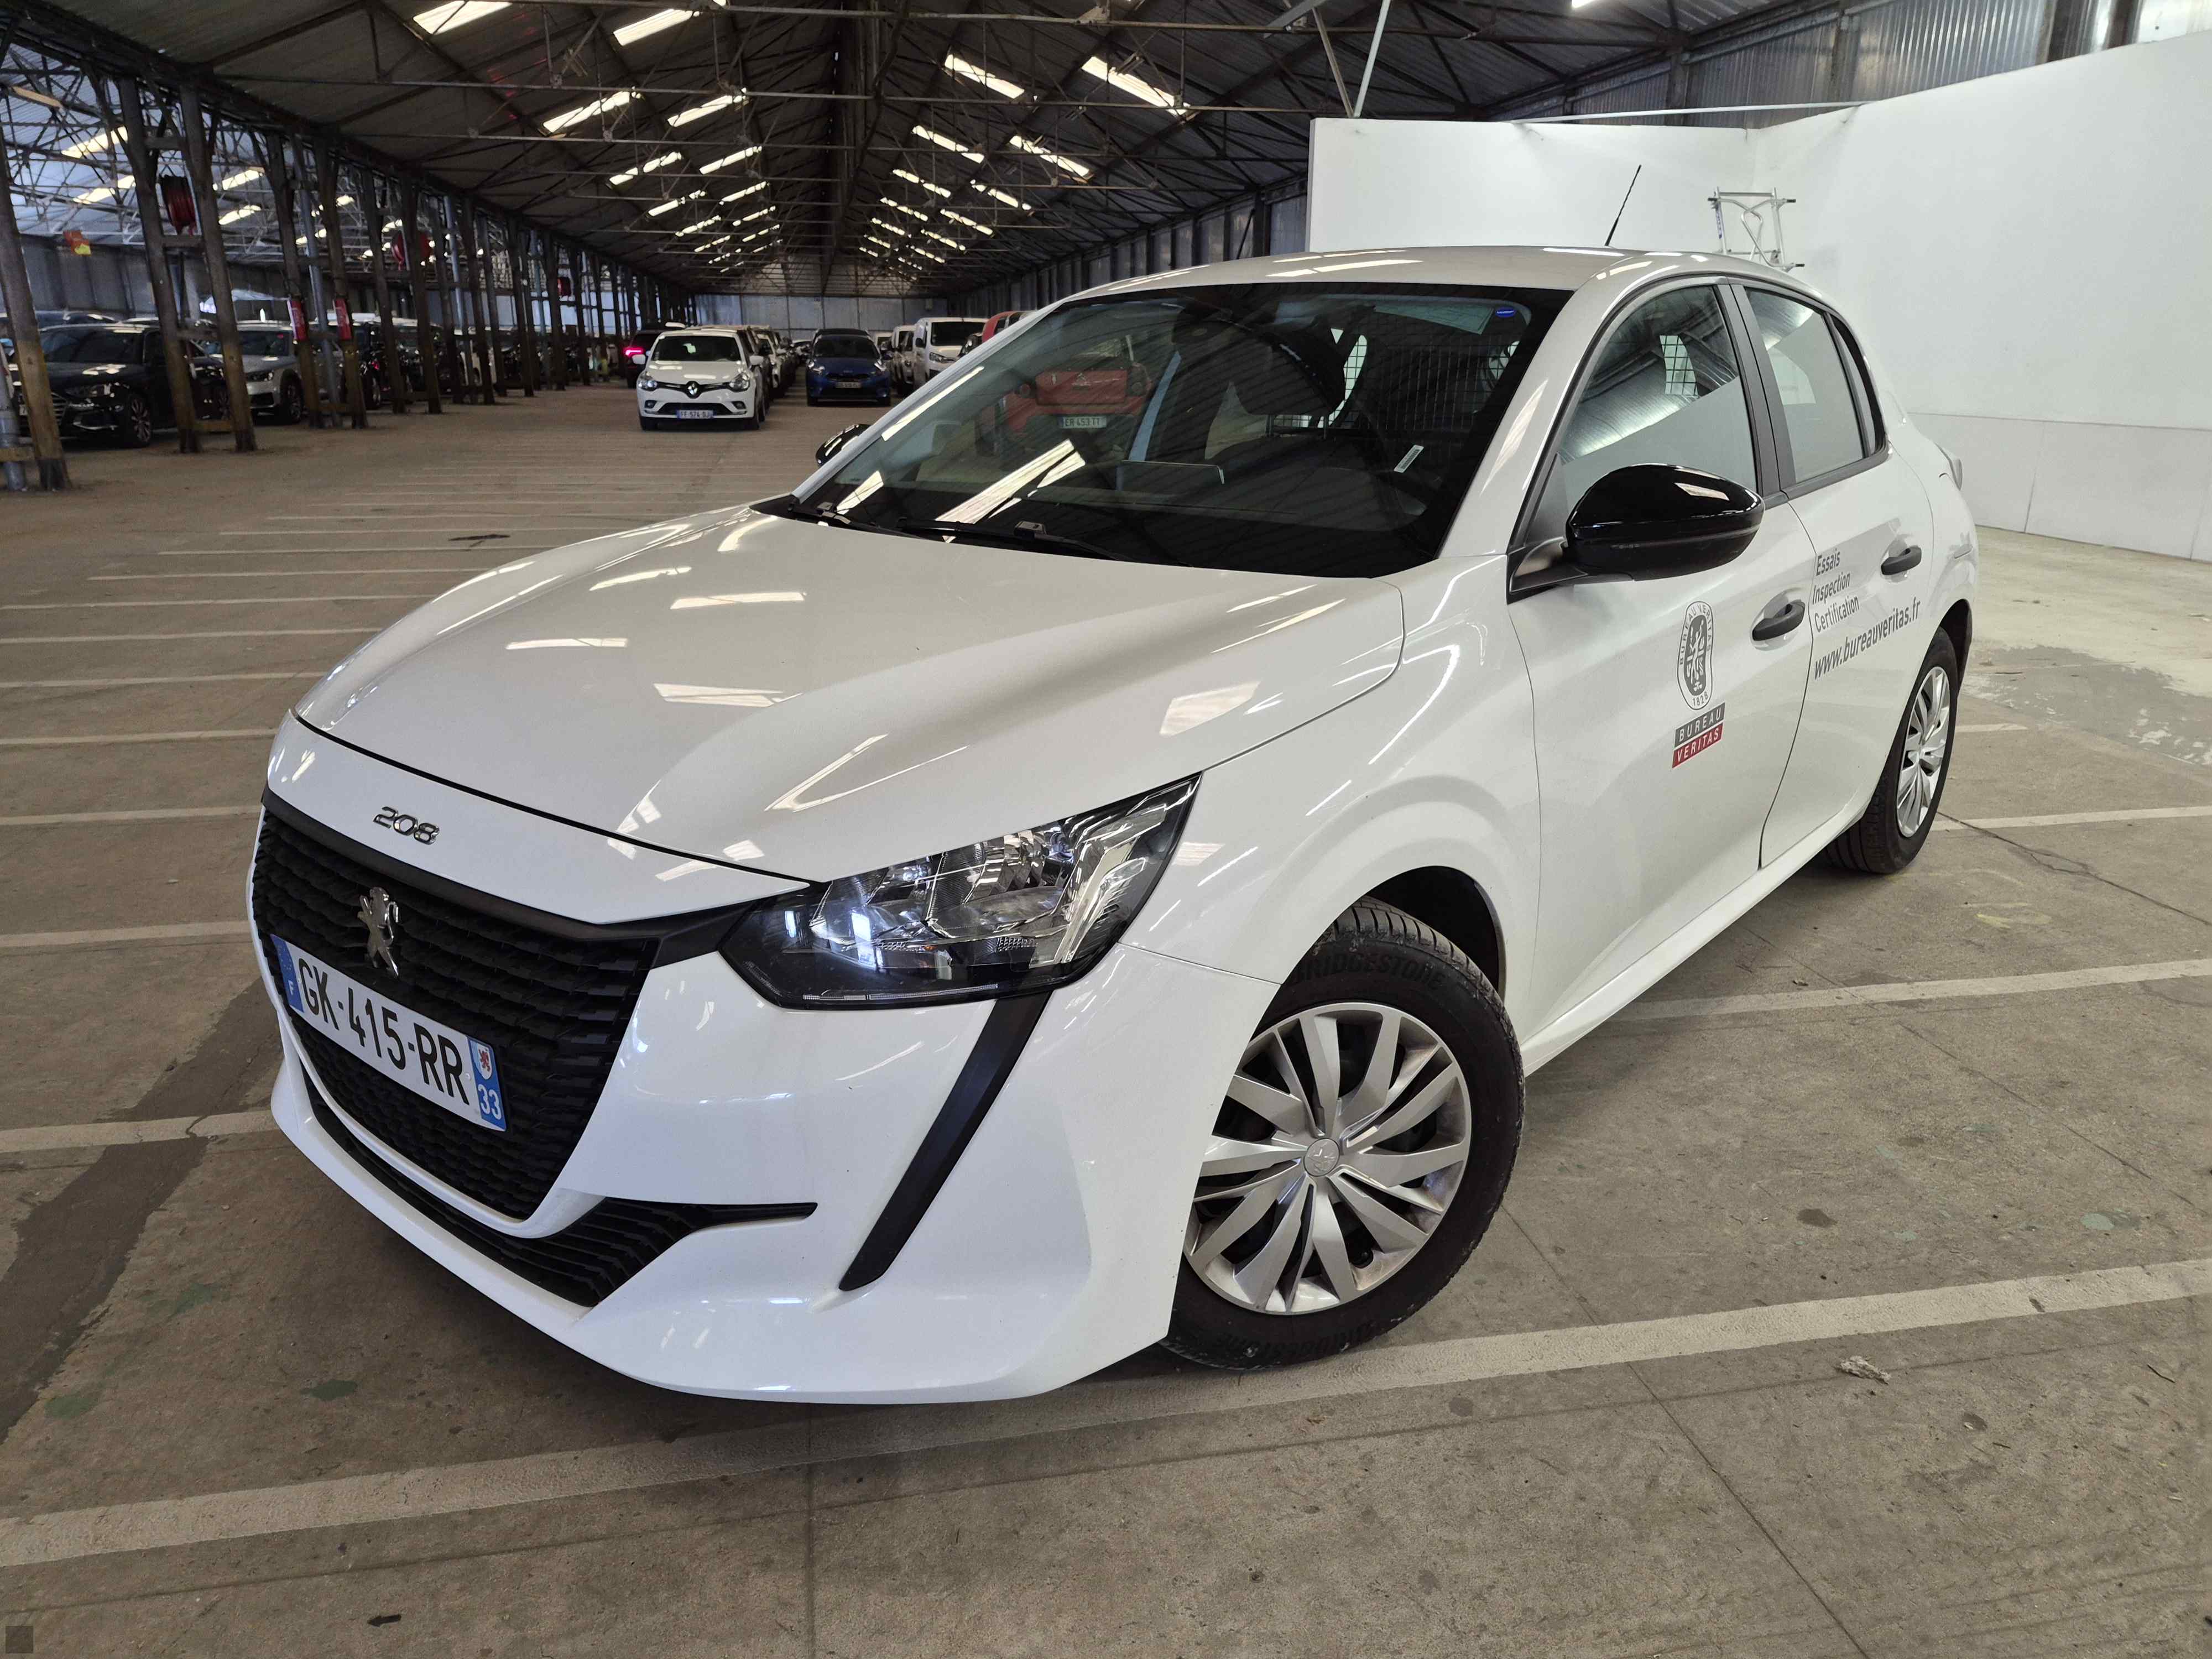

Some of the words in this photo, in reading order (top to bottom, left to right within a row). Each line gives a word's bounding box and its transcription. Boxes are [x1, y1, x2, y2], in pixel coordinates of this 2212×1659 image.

[1816, 549, 1840, 576] Essais
[1813, 572, 1850, 605] Inspection
[1814, 596, 1859, 633] Certification
[1814, 597, 1920, 680] www.bureauveritas.fr
[1693, 691, 1708, 706] 1828
[1679, 708, 1721, 742] BUREAU
[1678, 728, 1719, 762] VERITAS
[373, 806, 439, 845] 208
[288, 980, 294, 995] F
[299, 958, 469, 1105] GK-415-RR
[477, 1084, 502, 1120] 33
